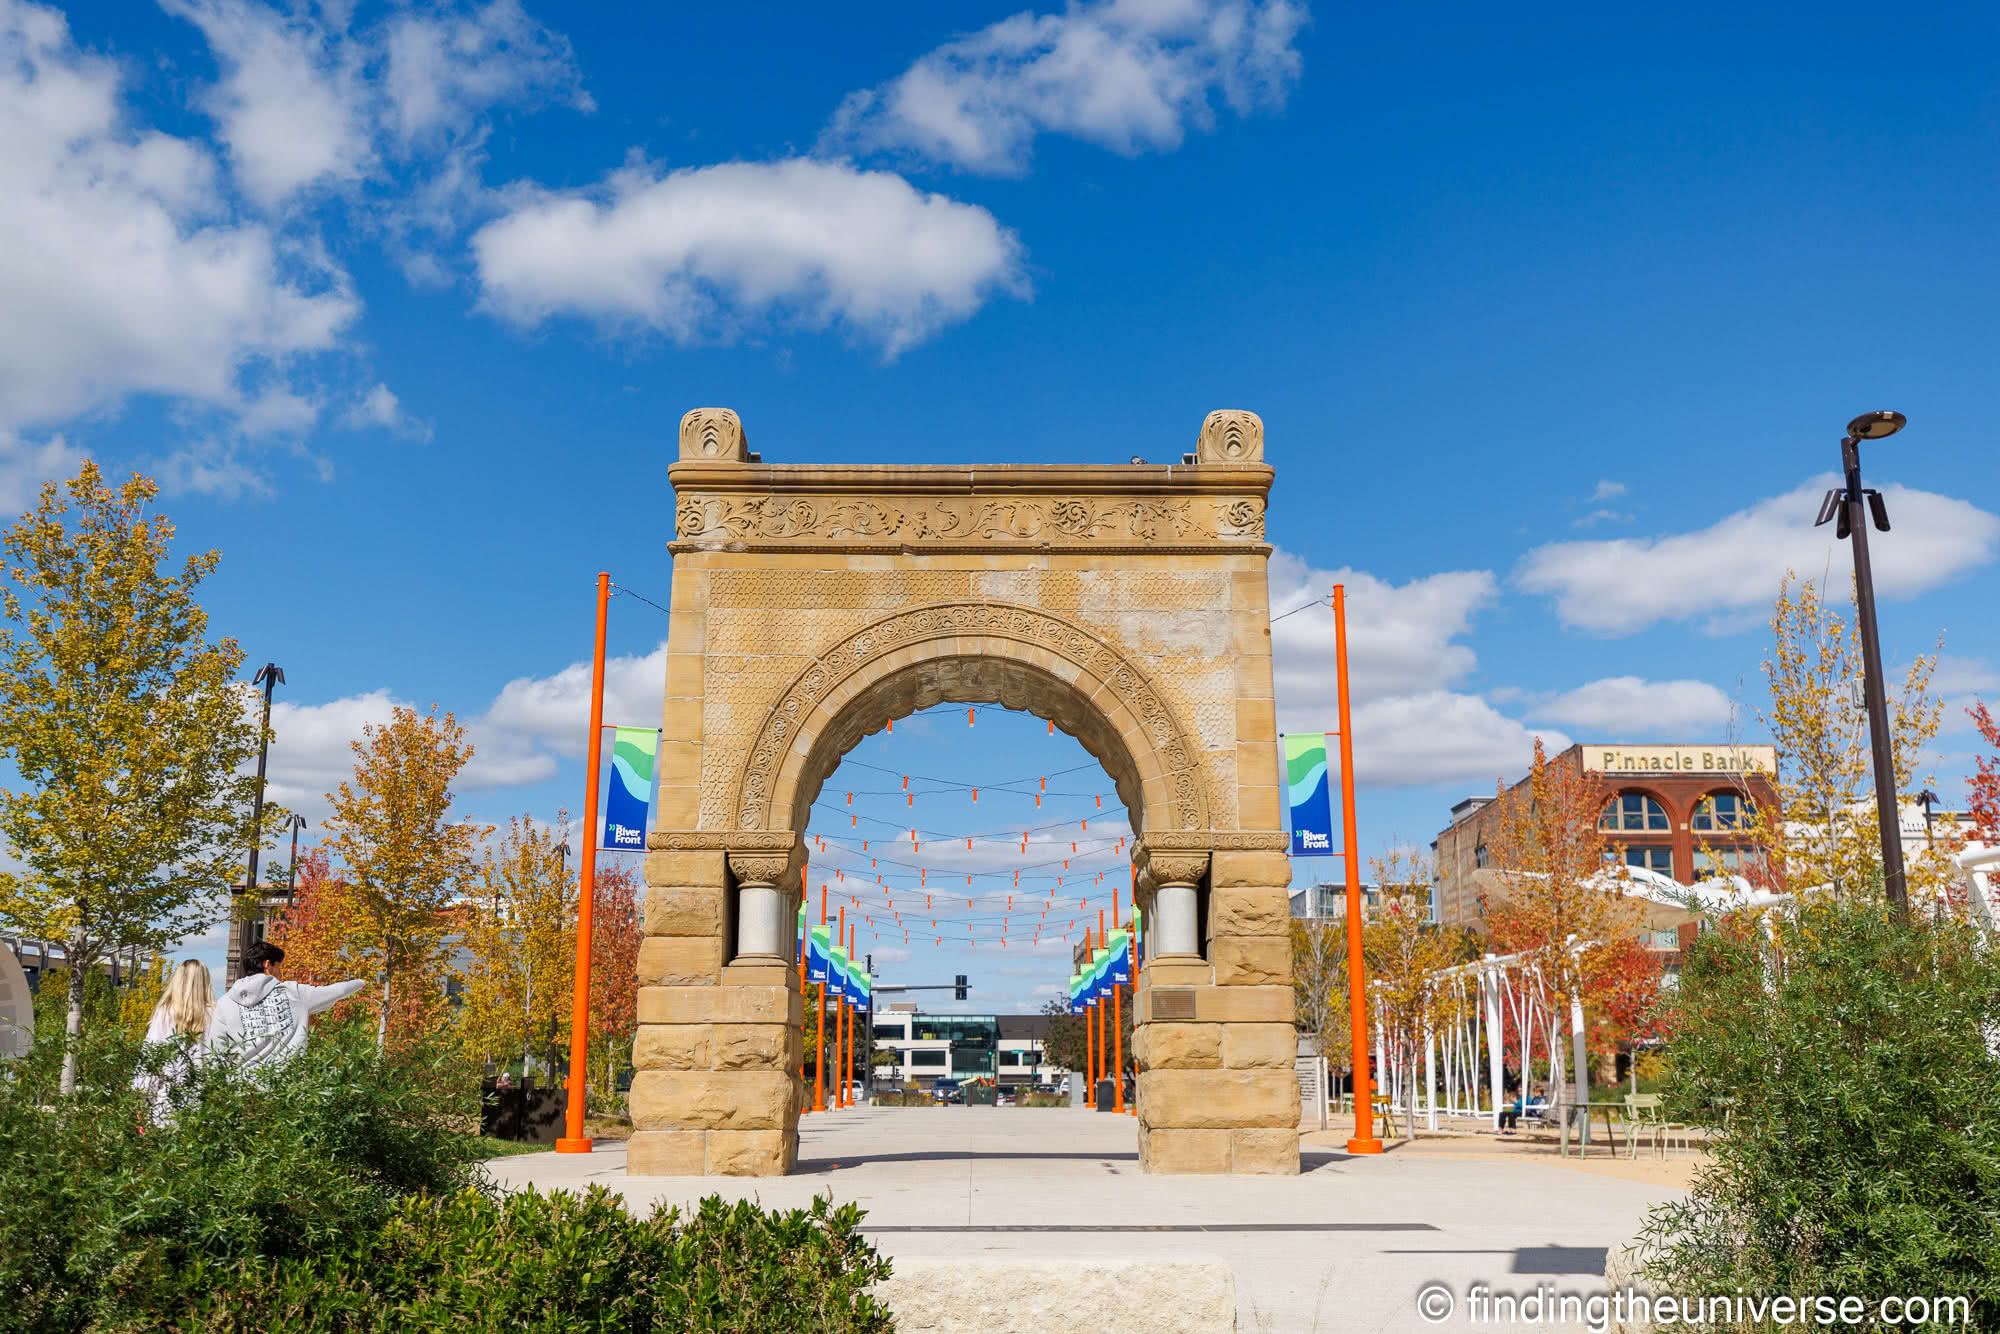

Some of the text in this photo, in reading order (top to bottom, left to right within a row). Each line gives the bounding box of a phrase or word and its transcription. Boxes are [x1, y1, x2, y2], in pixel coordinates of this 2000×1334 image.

[1603, 751, 1754, 770] Pinnacle Bank
[616, 826, 640, 837] River
[1303, 831, 1327, 841] River
[615, 835, 641, 845] Front
[1303, 839, 1329, 848] Front
